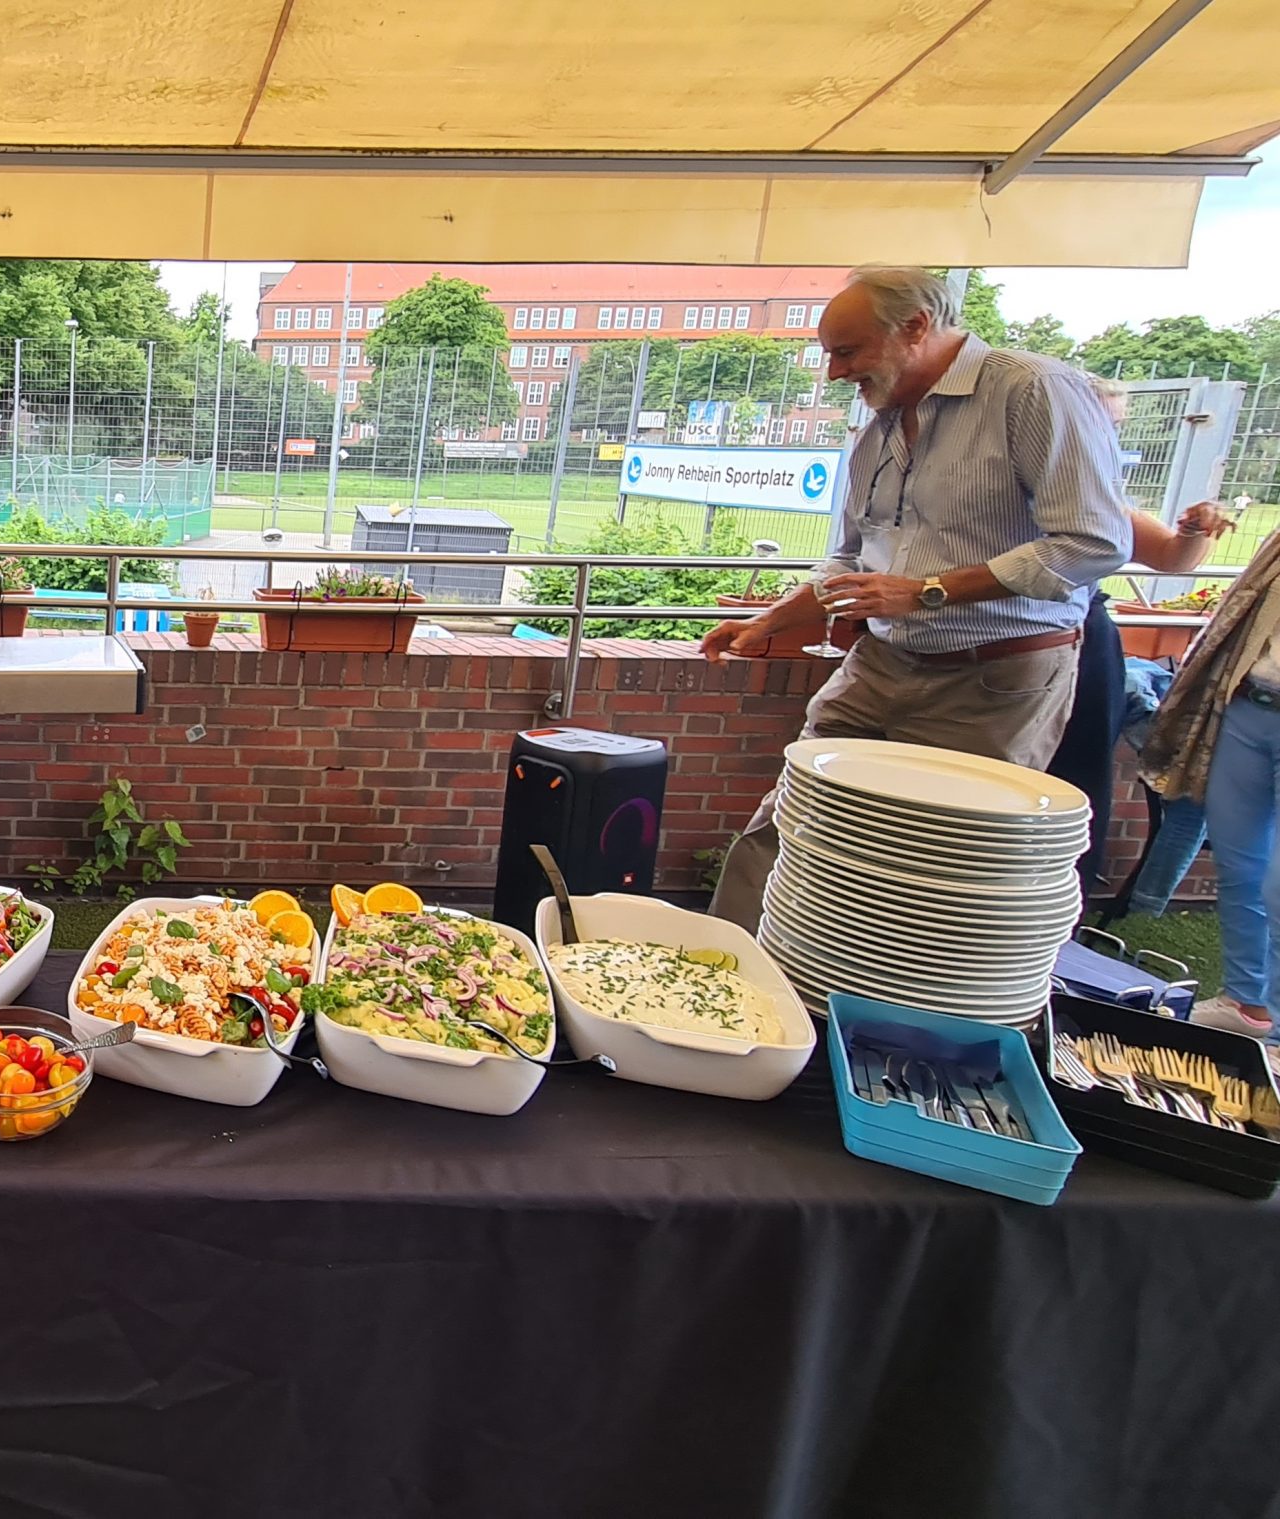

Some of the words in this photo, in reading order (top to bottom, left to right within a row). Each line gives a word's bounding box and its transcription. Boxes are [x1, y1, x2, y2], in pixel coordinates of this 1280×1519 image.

[688, 425, 713, 435] USC
[645, 463, 675, 483] Jonny
[677, 464, 721, 483] Rehbein
[725, 466, 795, 490] Sportplatz
